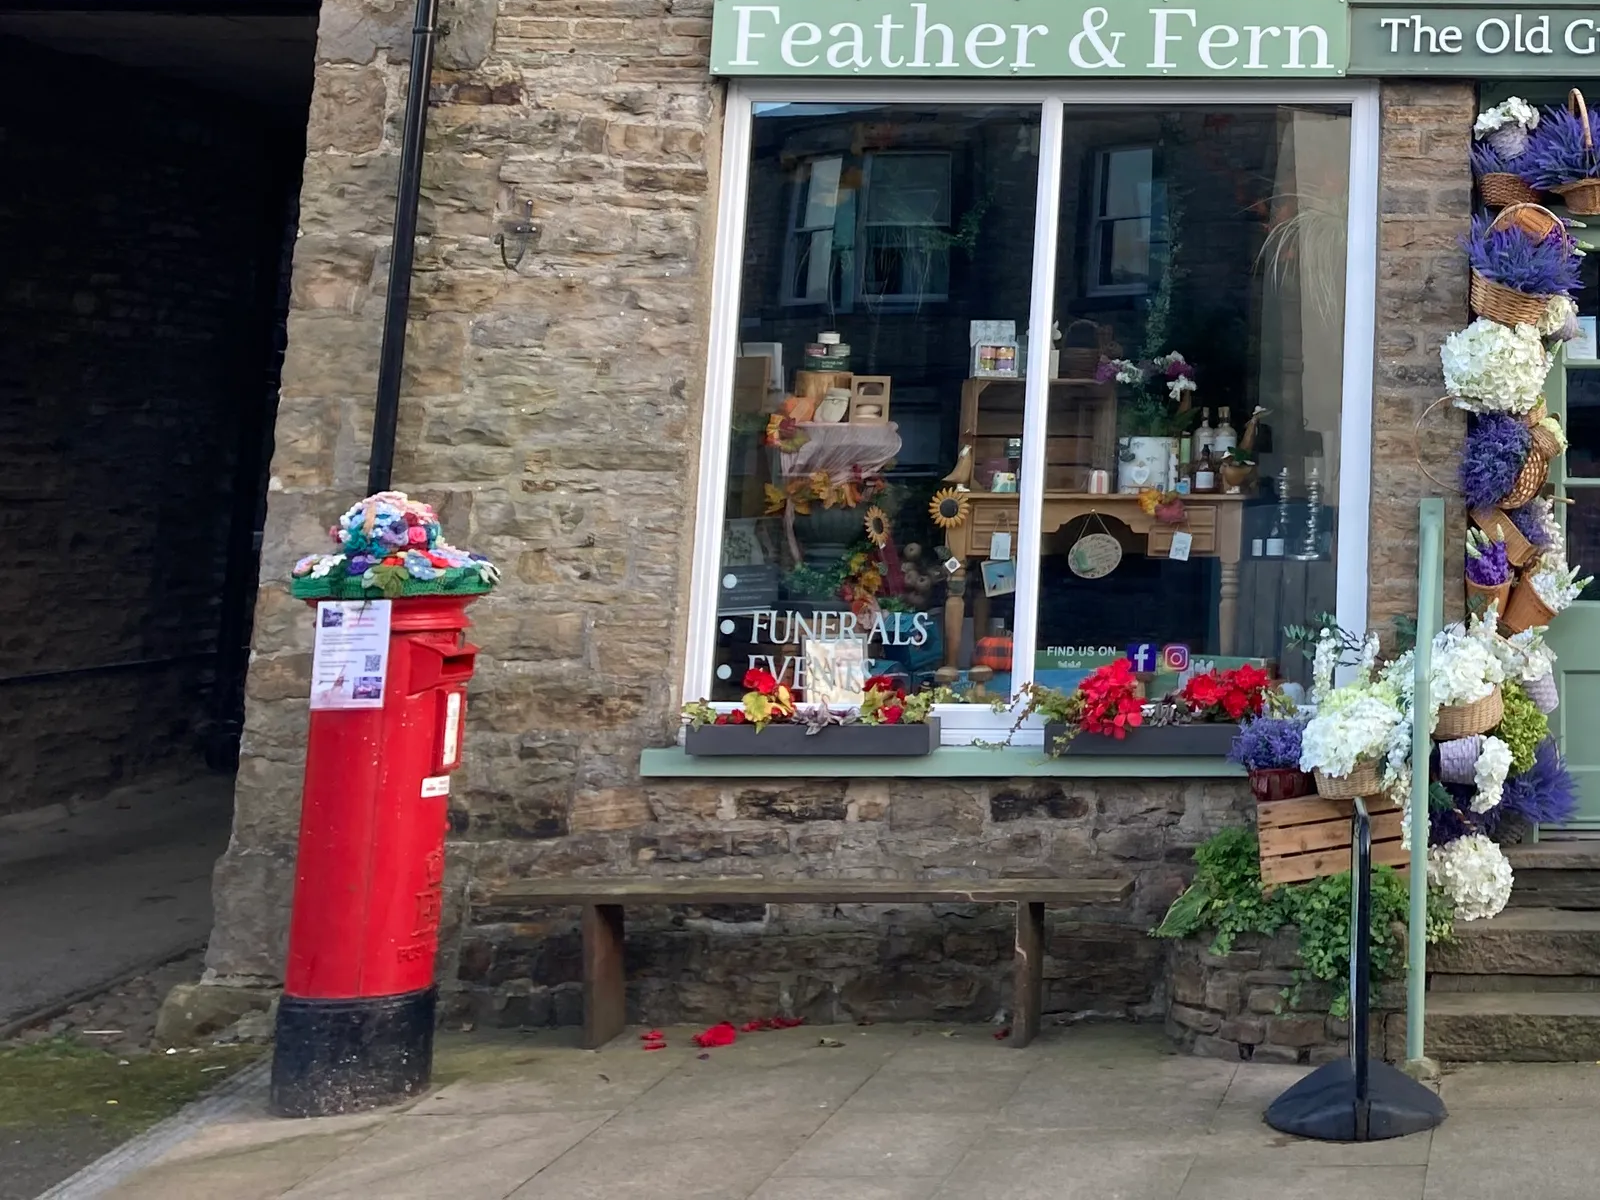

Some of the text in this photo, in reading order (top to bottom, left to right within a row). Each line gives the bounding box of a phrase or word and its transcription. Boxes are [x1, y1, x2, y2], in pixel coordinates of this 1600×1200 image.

[728, 3, 1334, 70] Feather & Fern
[1381, 15, 1462, 54] The
[1476, 15, 1553, 55] Old
[1047, 646, 1075, 657] FIND
[1078, 646, 1094, 657] US
[1098, 646, 1116, 657] ON
